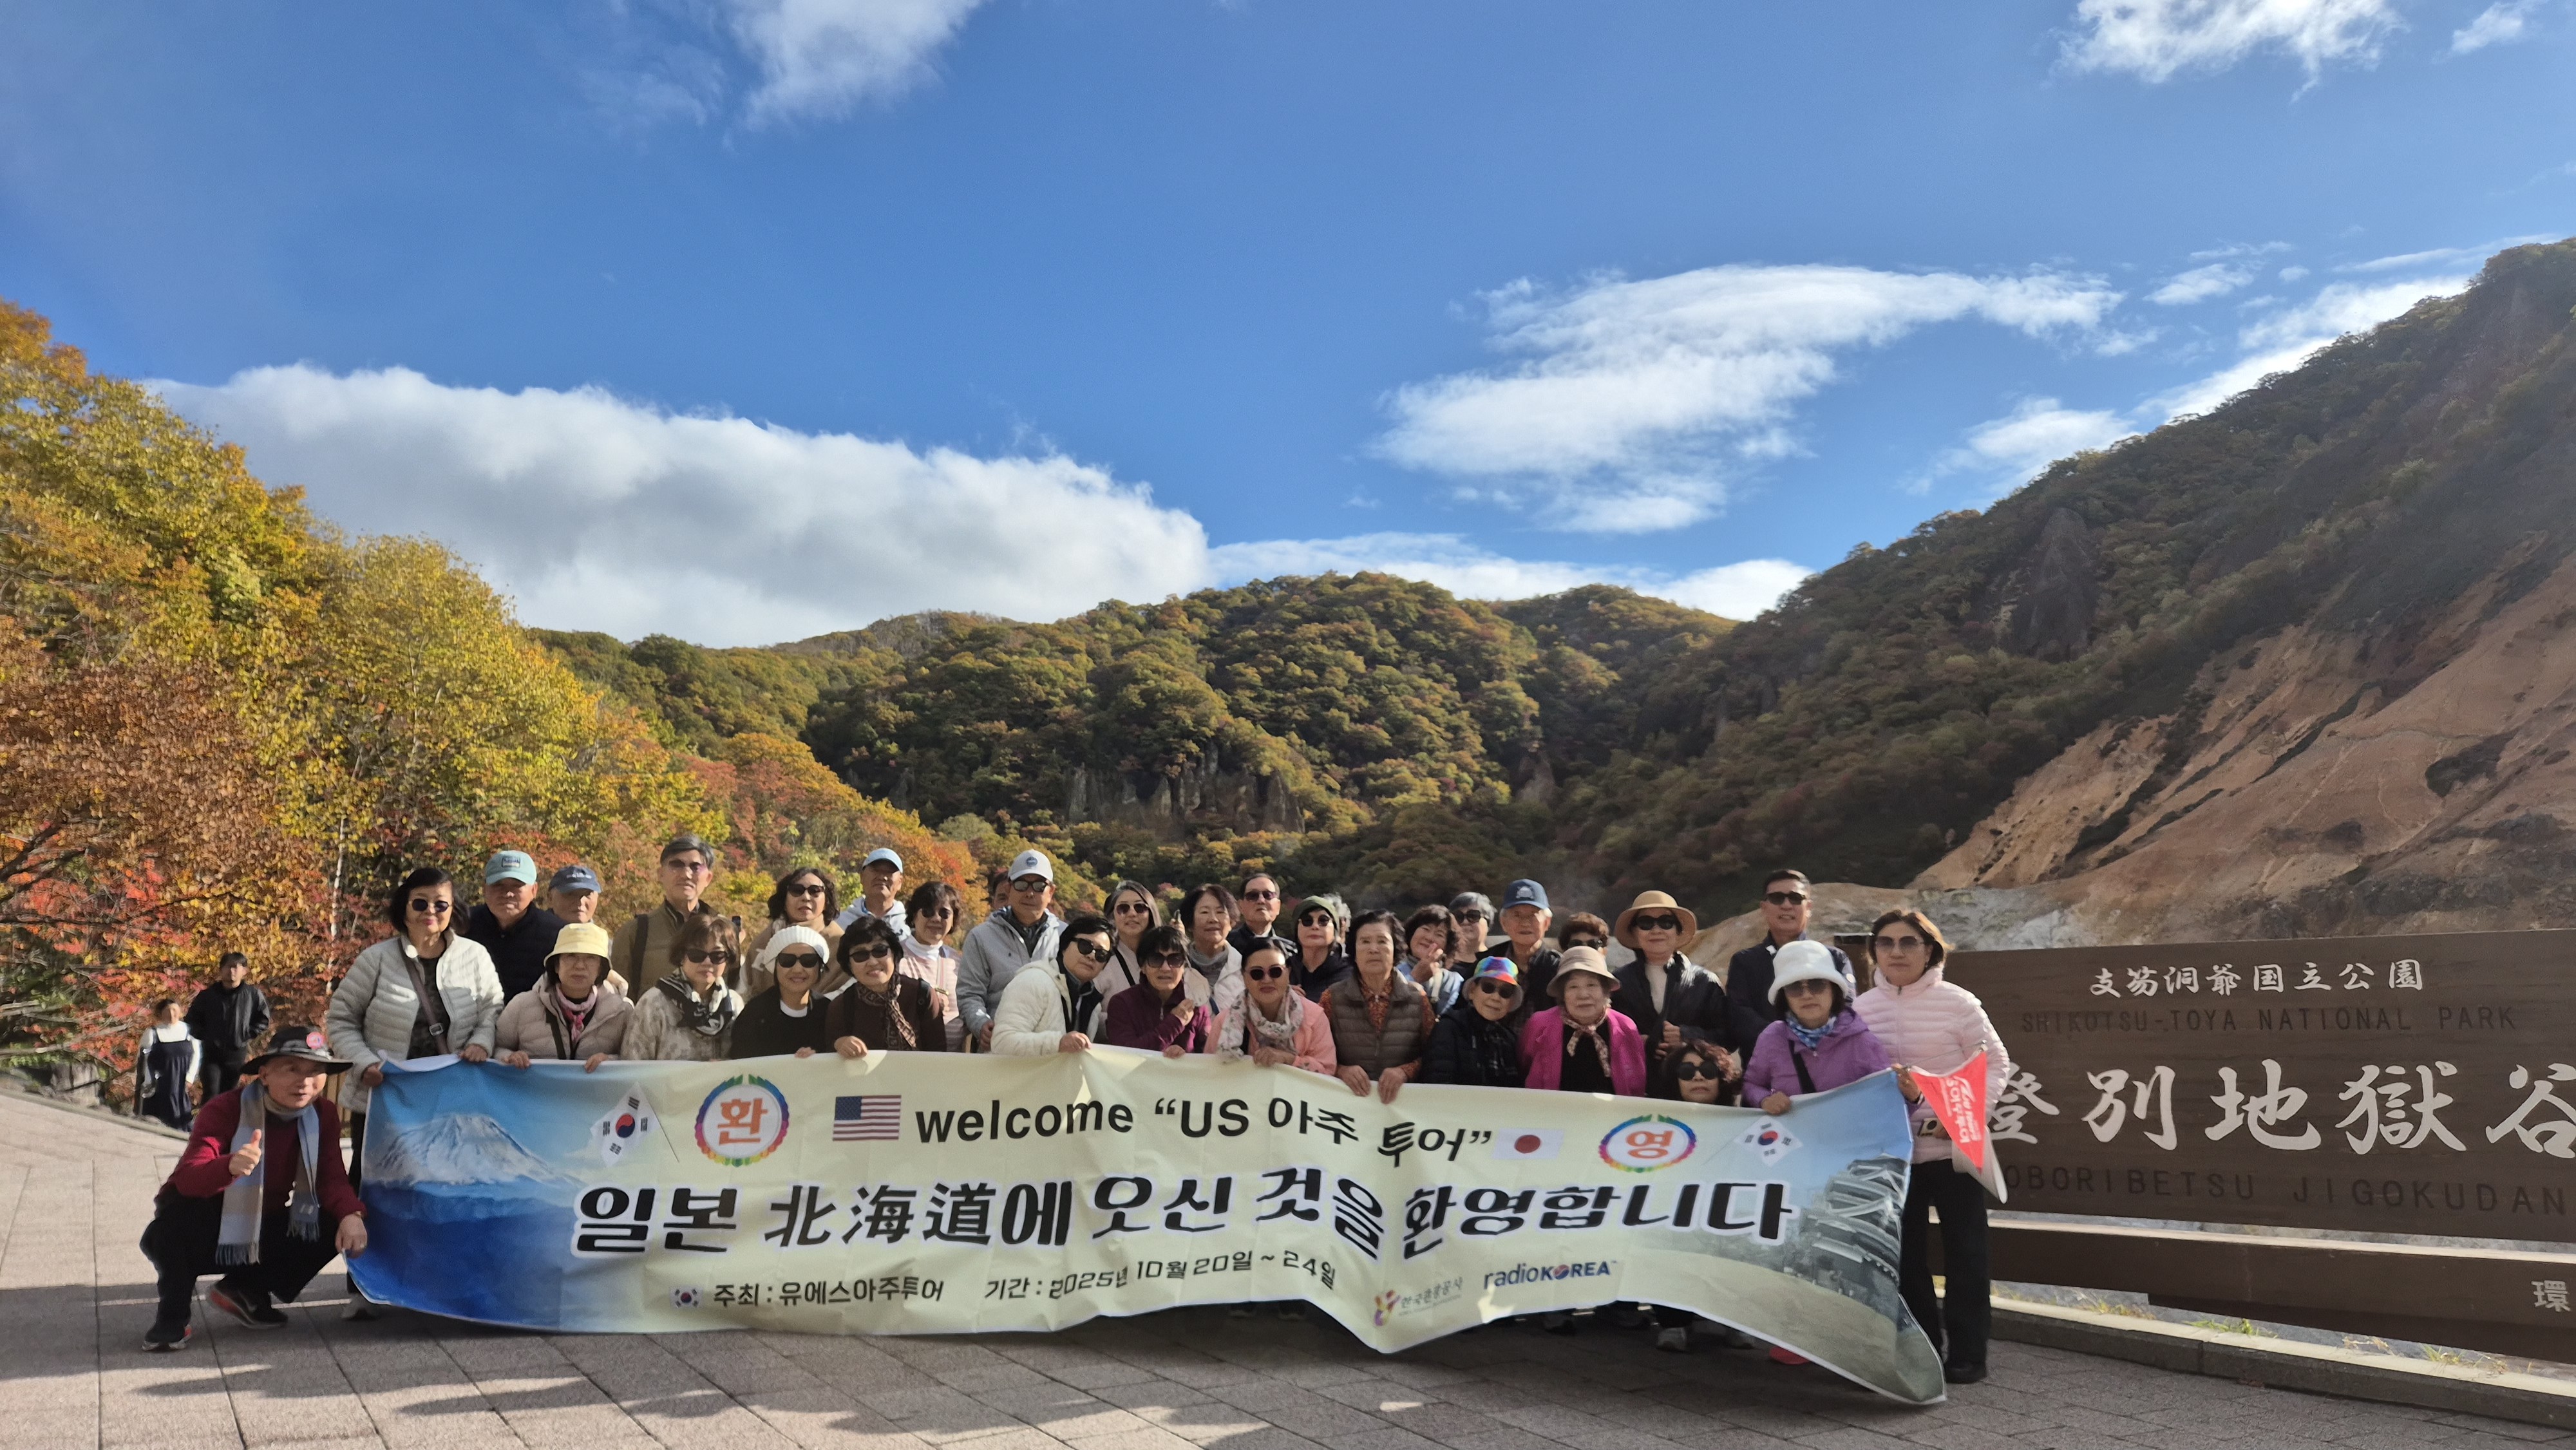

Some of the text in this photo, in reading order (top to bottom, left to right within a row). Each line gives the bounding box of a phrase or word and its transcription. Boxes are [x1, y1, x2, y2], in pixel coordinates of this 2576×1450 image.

[2022, 1006, 2515, 1033] SHIKOTSU-TOYA NATIONAL PARK
[717, 1097, 768, 1145] 환
[915, 1100, 1133, 1143] welcome
[1268, 1097, 1359, 1145] 아주
[1625, 1129, 1674, 1158] 영
[577, 1168, 1792, 1260] 일본 北海道에 오신 것을 환영합니다
[2005, 1164, 2566, 1216] OBORIBETSU JIGOKUDAN
[714, 1283, 759, 1307] 주최
[779, 1276, 945, 1306] 유에스아주투어
[985, 1277, 1030, 1299] 기간
[1048, 1265, 1128, 1299] 2025년
[1137, 1261, 1187, 1279] 10월
[1193, 1250, 1253, 1276] 20일
[1283, 1249, 1336, 1290] 24일
[2531, 1279, 2571, 1312] 環
